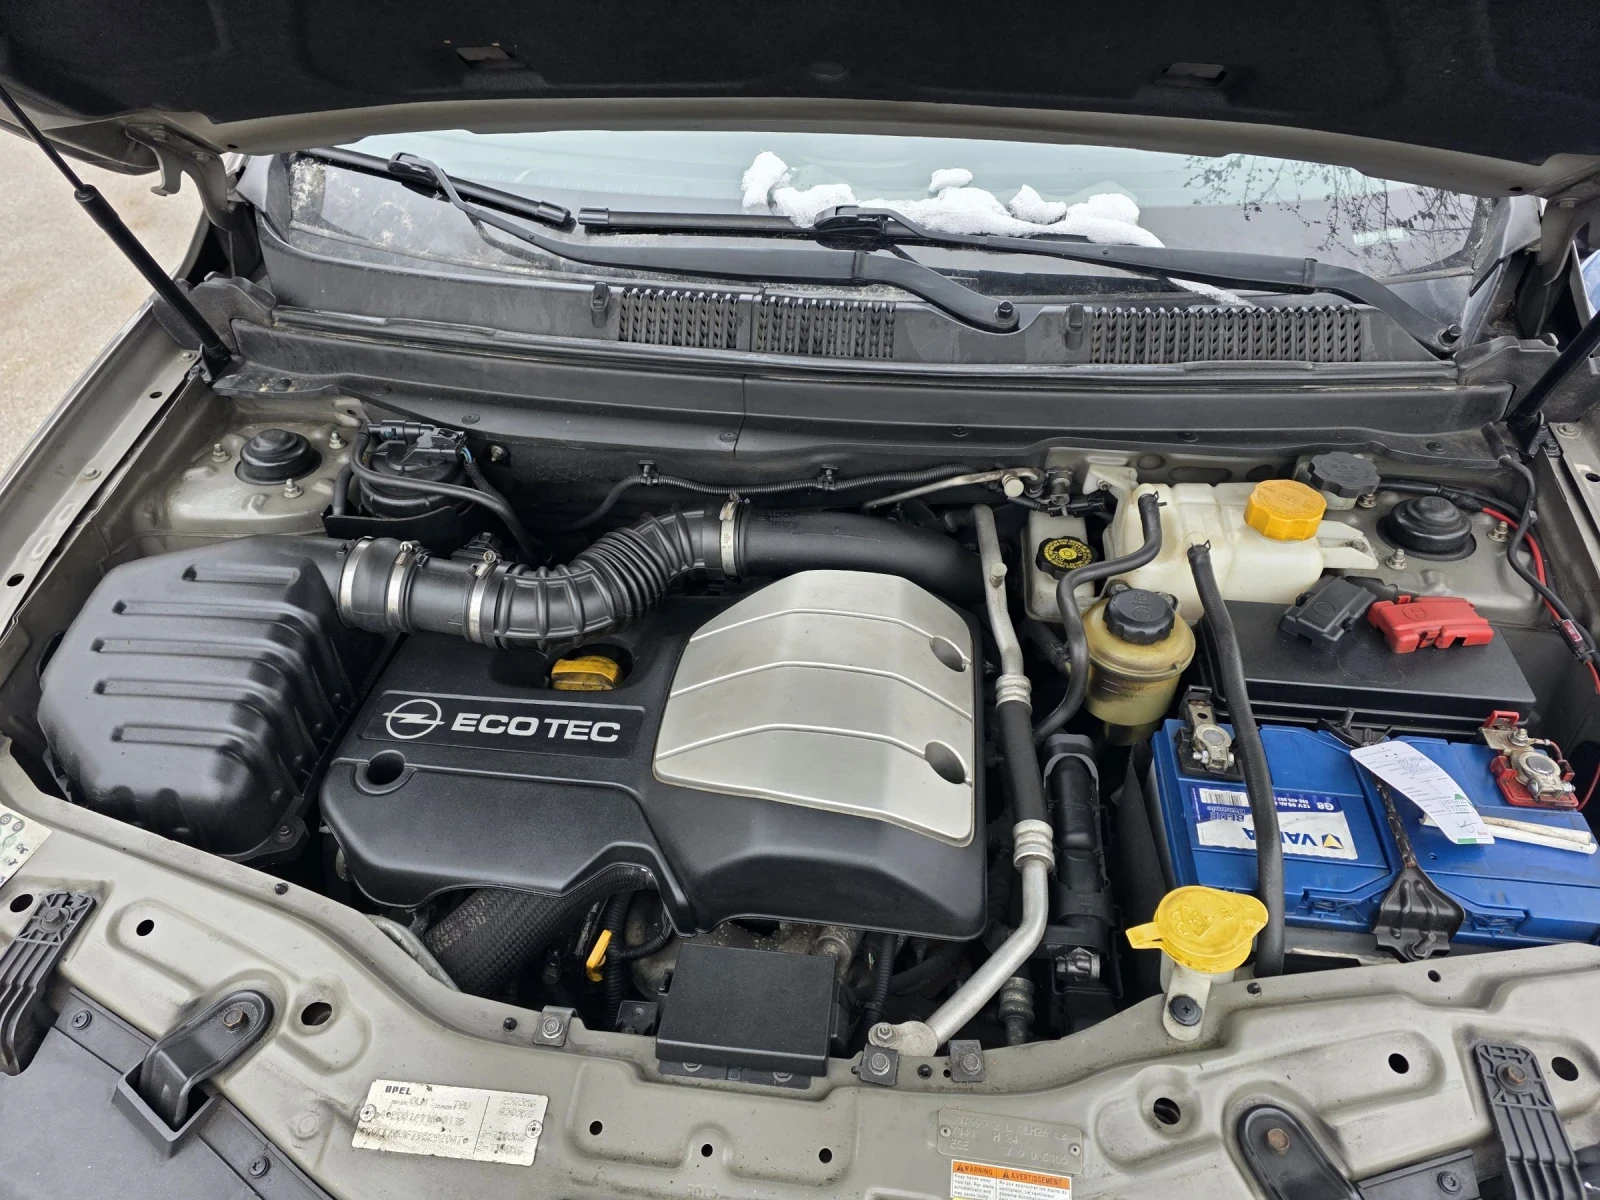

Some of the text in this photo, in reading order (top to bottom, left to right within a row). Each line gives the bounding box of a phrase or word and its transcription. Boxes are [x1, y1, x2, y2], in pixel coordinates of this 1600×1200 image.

[1207, 805, 1246, 816] Dynamic
[1316, 801, 1335, 811] G8
[1210, 811, 1245, 822] BLUE
[1243, 827, 1318, 847] VAA
[384, 1084, 412, 1096] OPEL
[963, 1165, 993, 1176] WARNING
[1010, 1172, 1063, 1186] AVERTISSEMENT
